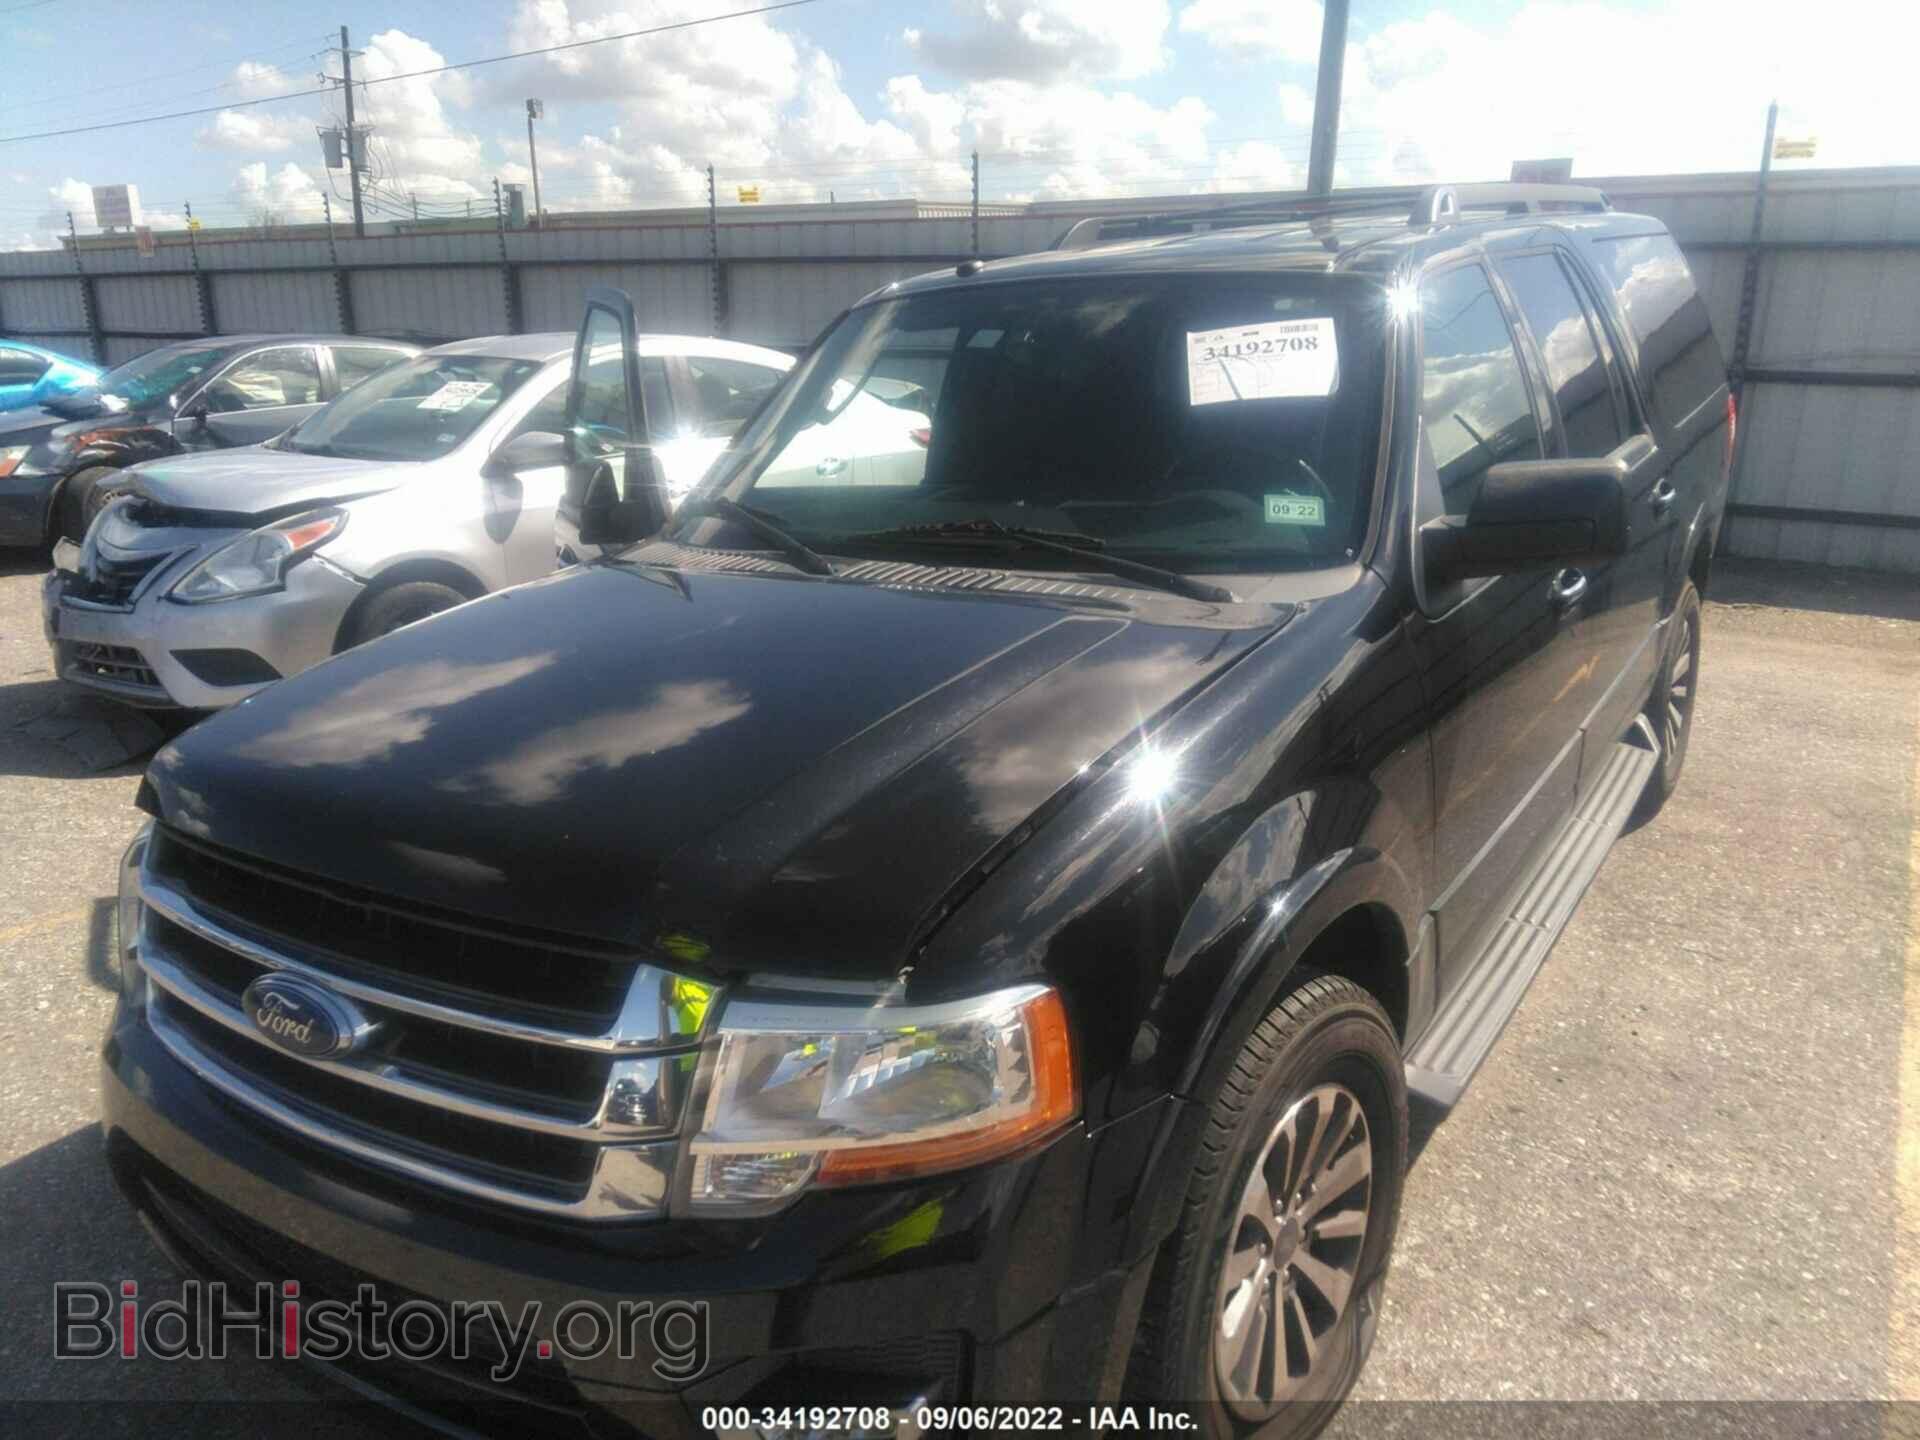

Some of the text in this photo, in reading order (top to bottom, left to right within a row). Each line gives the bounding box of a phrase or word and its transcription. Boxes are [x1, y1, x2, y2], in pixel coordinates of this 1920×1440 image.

[1204, 336, 1319, 361] 34192708
[1271, 503, 1316, 517] 09 22
[256, 991, 315, 1044] Ford
